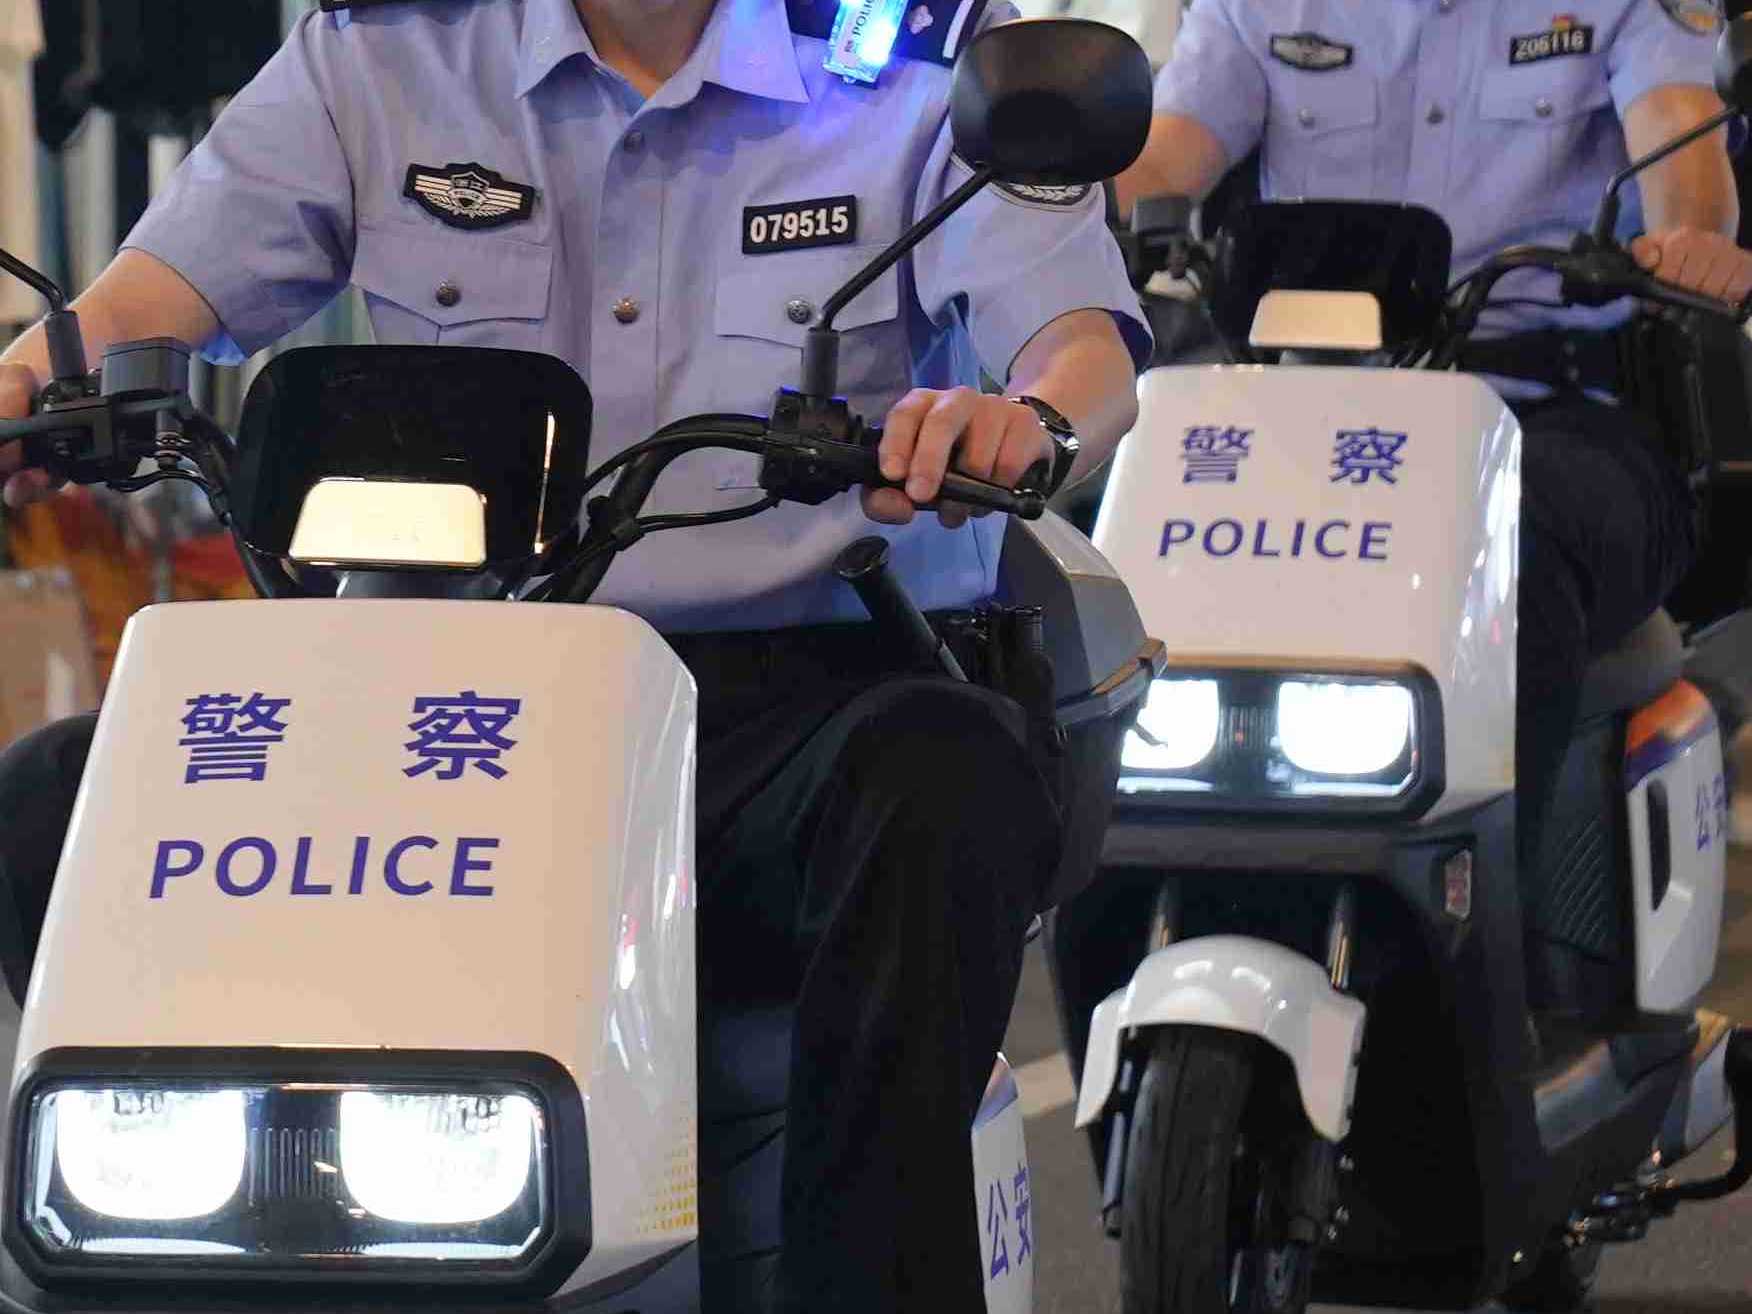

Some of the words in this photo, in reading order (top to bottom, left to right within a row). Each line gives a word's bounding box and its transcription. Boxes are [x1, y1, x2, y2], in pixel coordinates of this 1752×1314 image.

[750, 205, 849, 244] 079515
[1179, 424, 1409, 486] 警察
[1157, 517, 1393, 561] POLICE
[178, 690, 522, 784] 警察
[148, 834, 501, 900] POLICE
